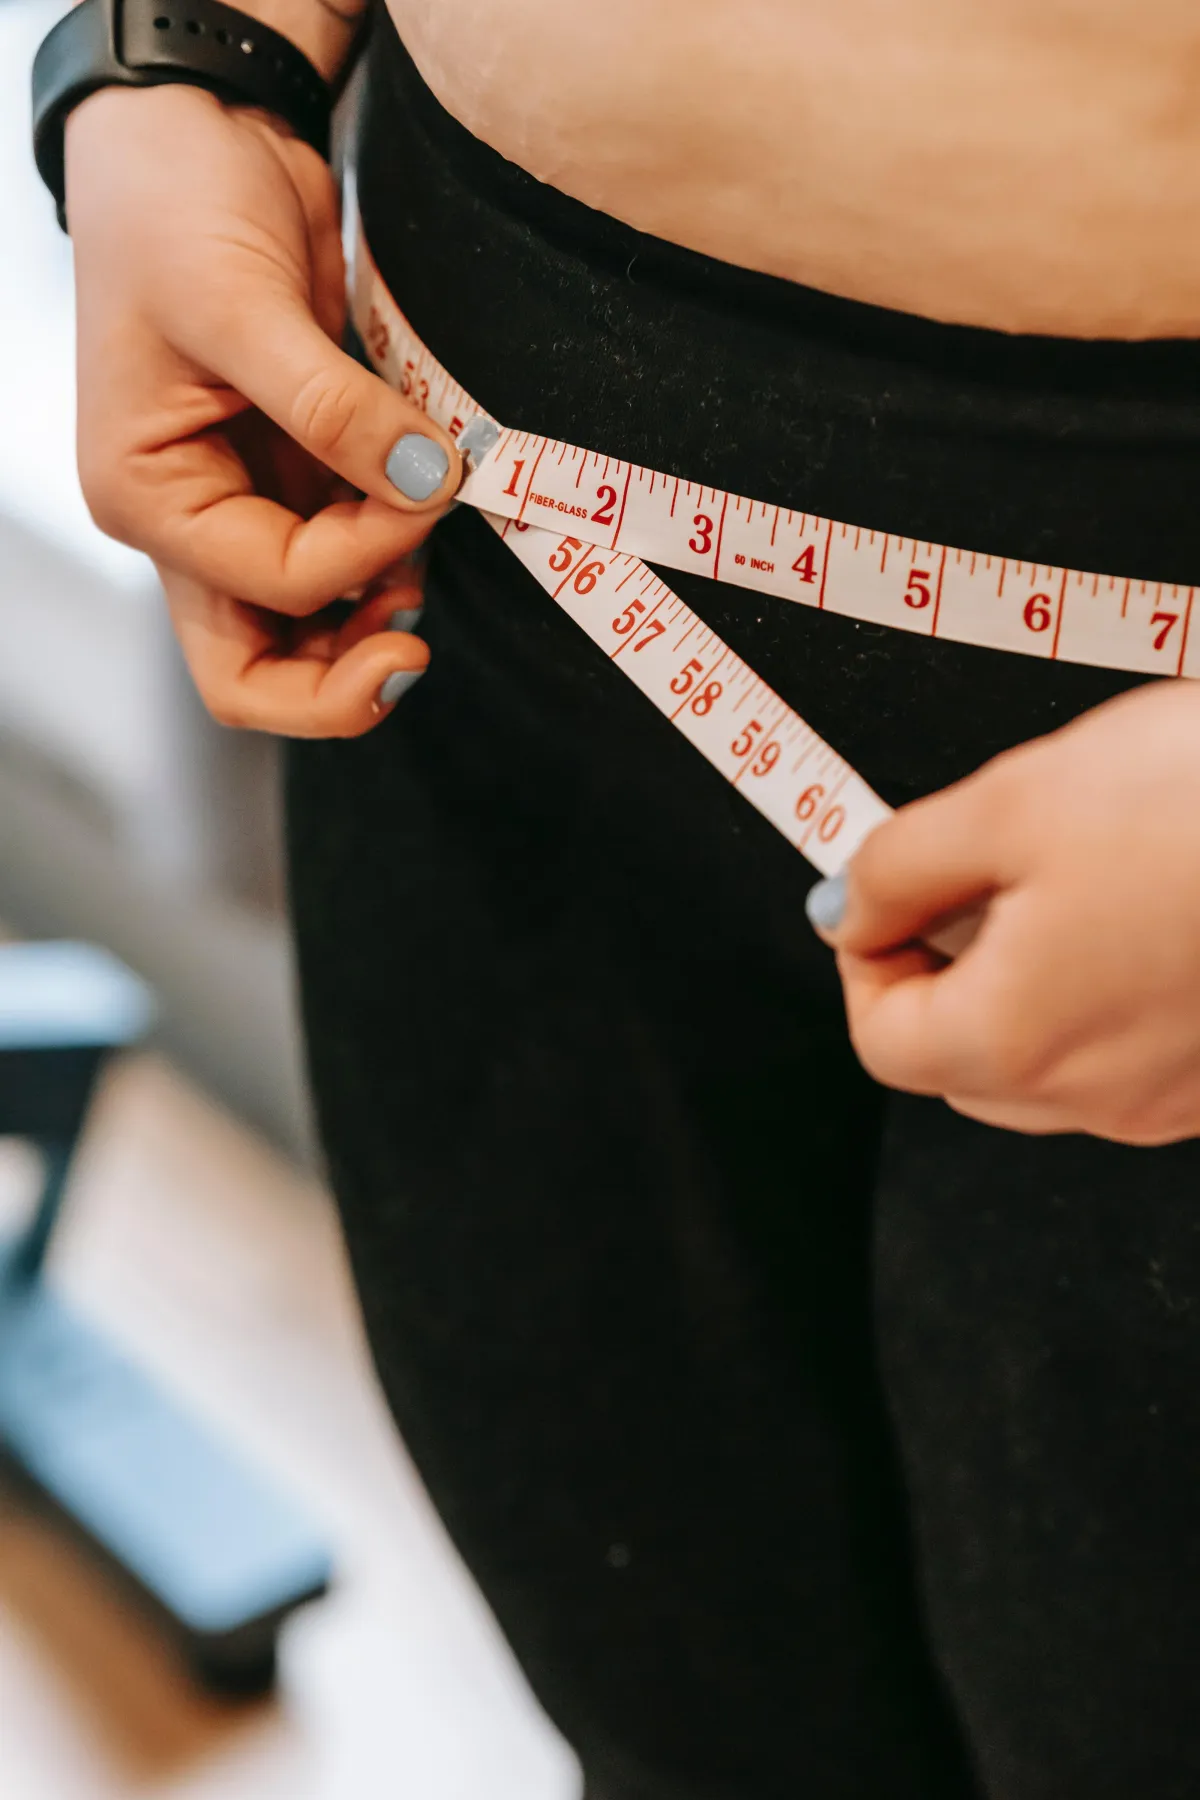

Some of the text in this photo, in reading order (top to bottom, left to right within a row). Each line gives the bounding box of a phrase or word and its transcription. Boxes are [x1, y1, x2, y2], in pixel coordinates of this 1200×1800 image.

[529, 492, 588, 519] FIBER-GLASS
[502, 459, 1179, 651] 1 2 3 4 5 6 7
[549, 536, 606, 595] 56
[734, 553, 775, 573] 60 INCH
[612, 598, 667, 653] 57
[670, 658, 723, 716] 58
[730, 719, 781, 777] 59
[794, 783, 845, 843] 60
